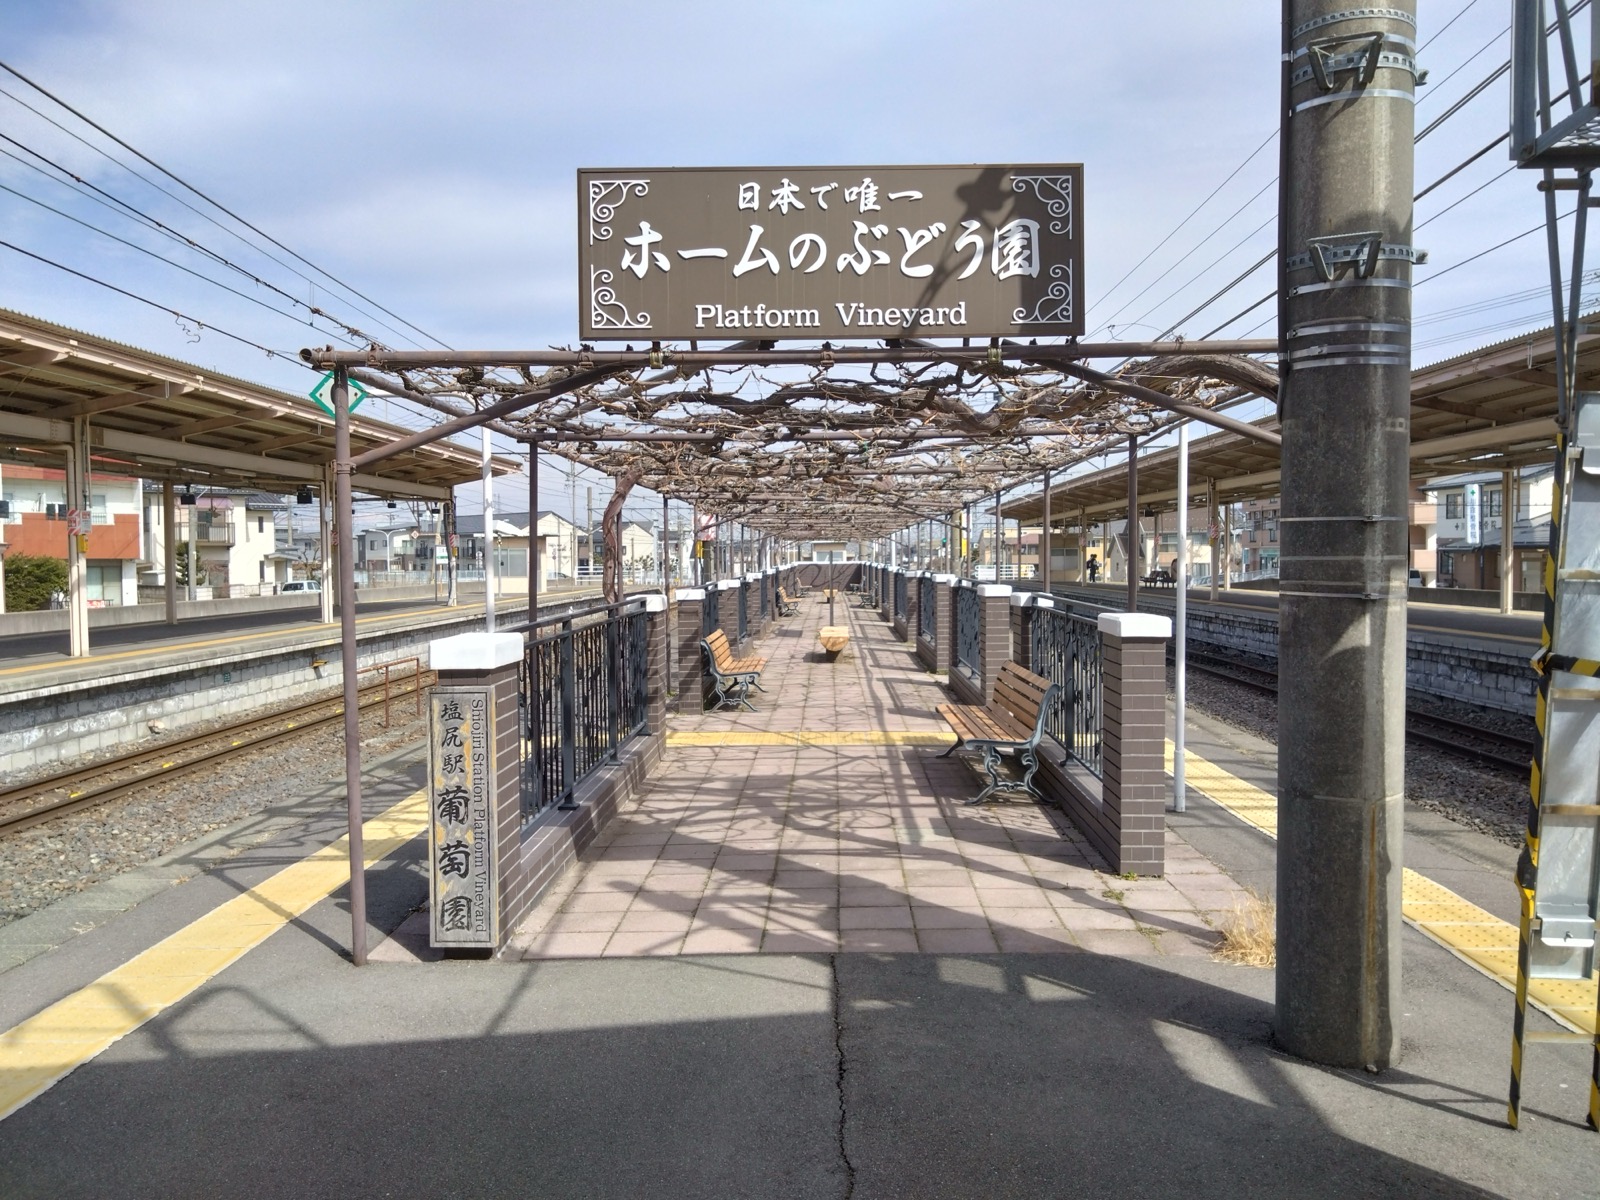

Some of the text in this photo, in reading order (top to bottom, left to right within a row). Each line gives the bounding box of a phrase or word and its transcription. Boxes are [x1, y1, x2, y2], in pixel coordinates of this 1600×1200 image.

[738, 177, 924, 215] 日本で唯一
[621, 218, 1041, 281] ホームのぶどう園
[695, 302, 968, 329] Platform Vineyard
[437, 699, 474, 933] 塩尻駅葡萄園
[471, 699, 488, 933] Shiojiri Station Platform Vineyard
